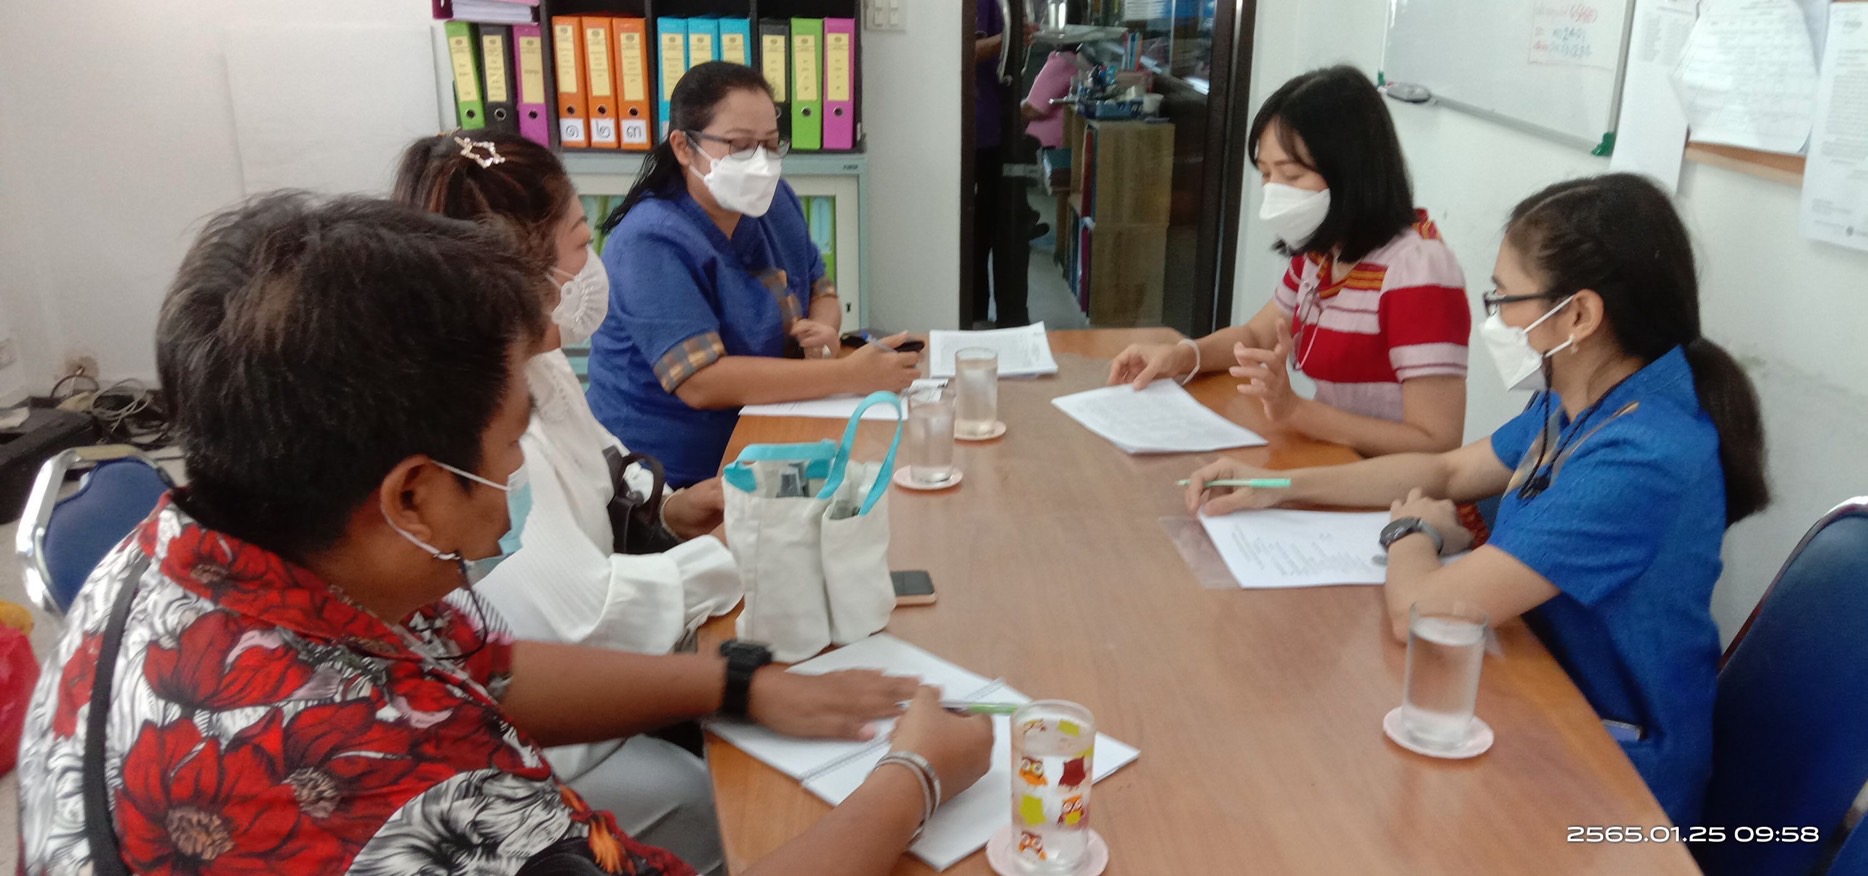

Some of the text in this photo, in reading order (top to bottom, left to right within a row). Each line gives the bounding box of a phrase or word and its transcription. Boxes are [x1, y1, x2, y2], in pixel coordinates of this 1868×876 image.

[565, 124, 579, 138] ๑
[595, 119, 611, 139] ๒
[626, 124, 642, 139] ๓
